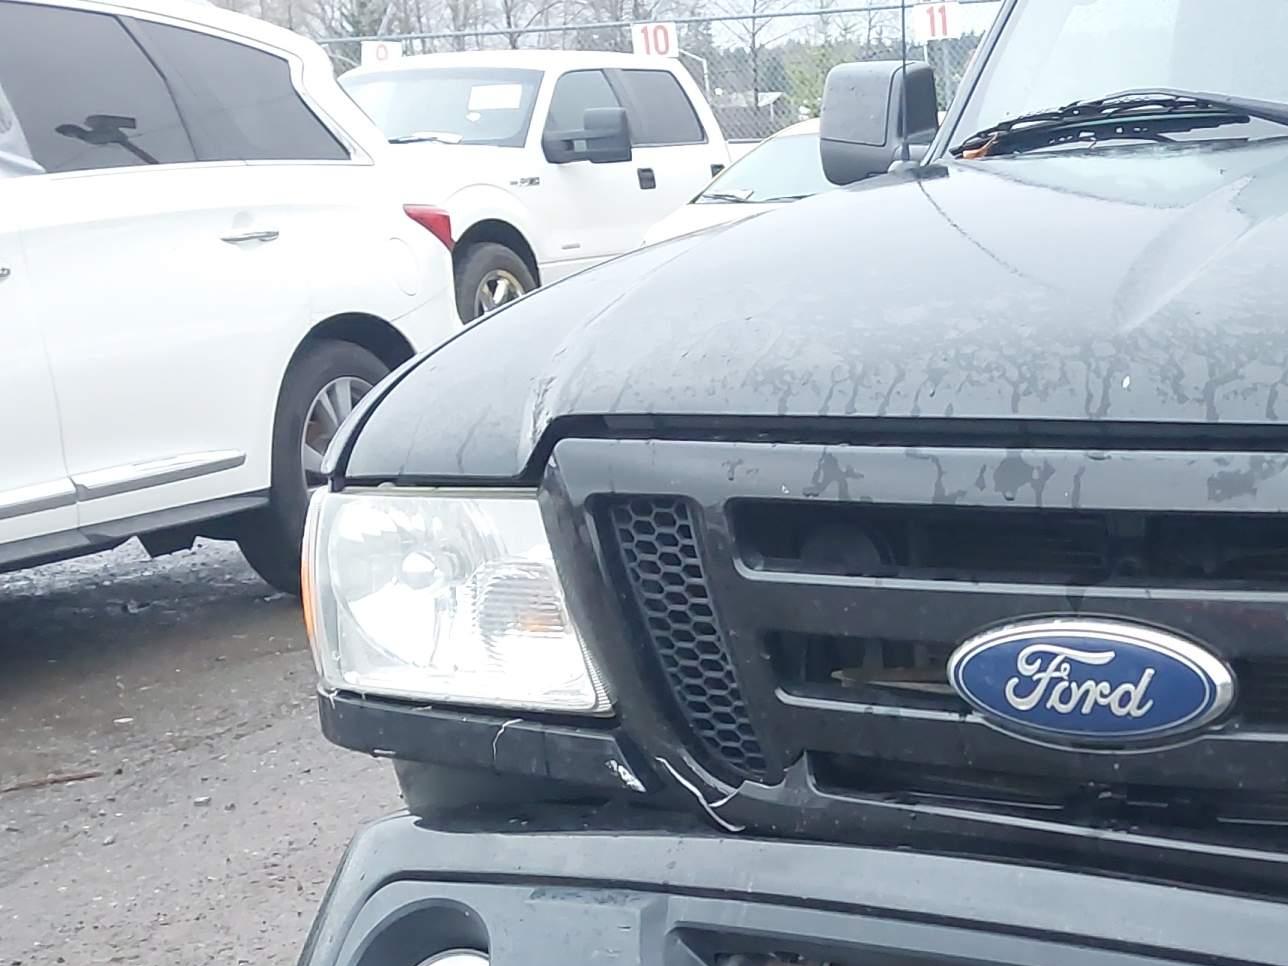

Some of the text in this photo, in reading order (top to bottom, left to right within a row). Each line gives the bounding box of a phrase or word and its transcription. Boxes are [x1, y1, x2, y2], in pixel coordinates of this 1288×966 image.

[926, 4, 947, 37] 11
[640, 24, 669, 55] 10
[1004, 643, 1157, 718] Ford
